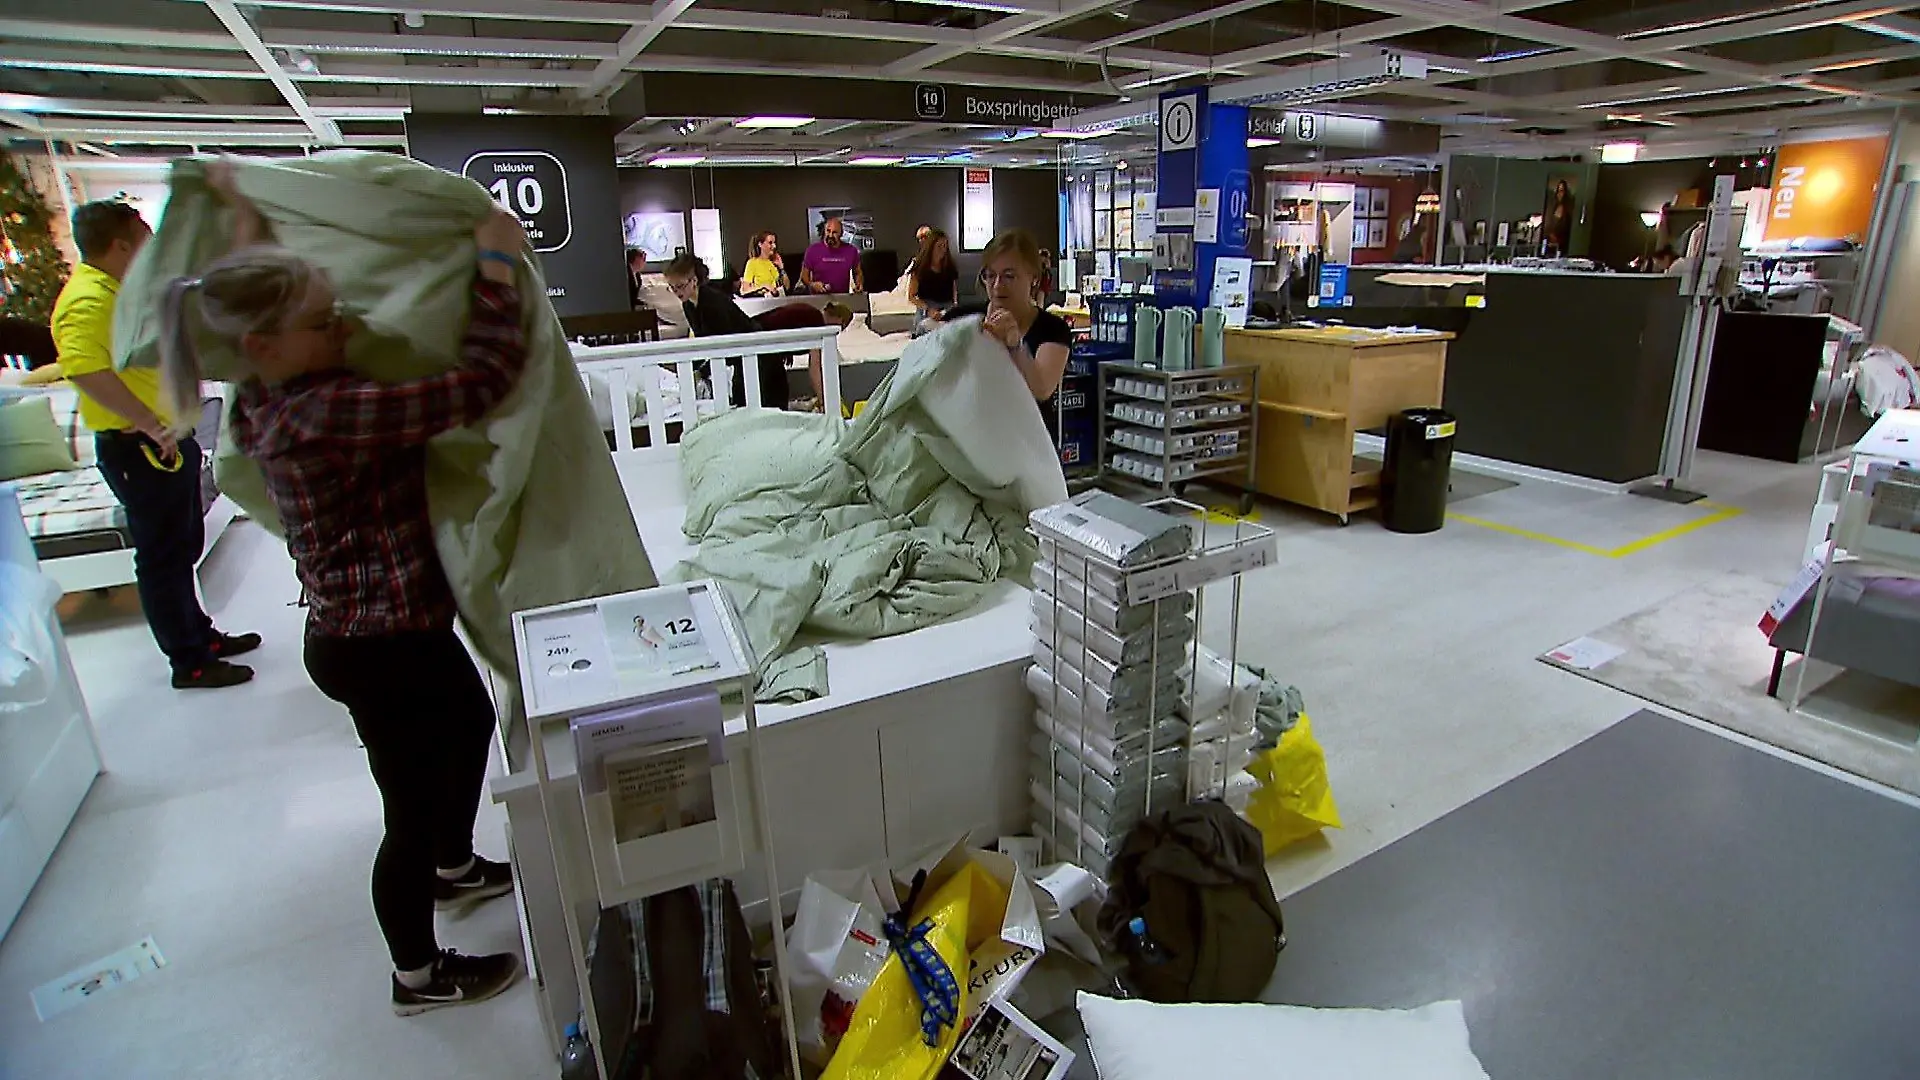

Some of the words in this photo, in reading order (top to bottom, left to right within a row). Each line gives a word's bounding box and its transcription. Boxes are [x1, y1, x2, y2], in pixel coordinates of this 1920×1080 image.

[923, 92, 937, 105] 10
[966, 97, 1082, 122] Boxspringbette
[494, 162, 534, 172] Inklusive
[490, 177, 543, 214] 10
[1774, 166, 1805, 218] Neu
[665, 618, 696, 635] 12
